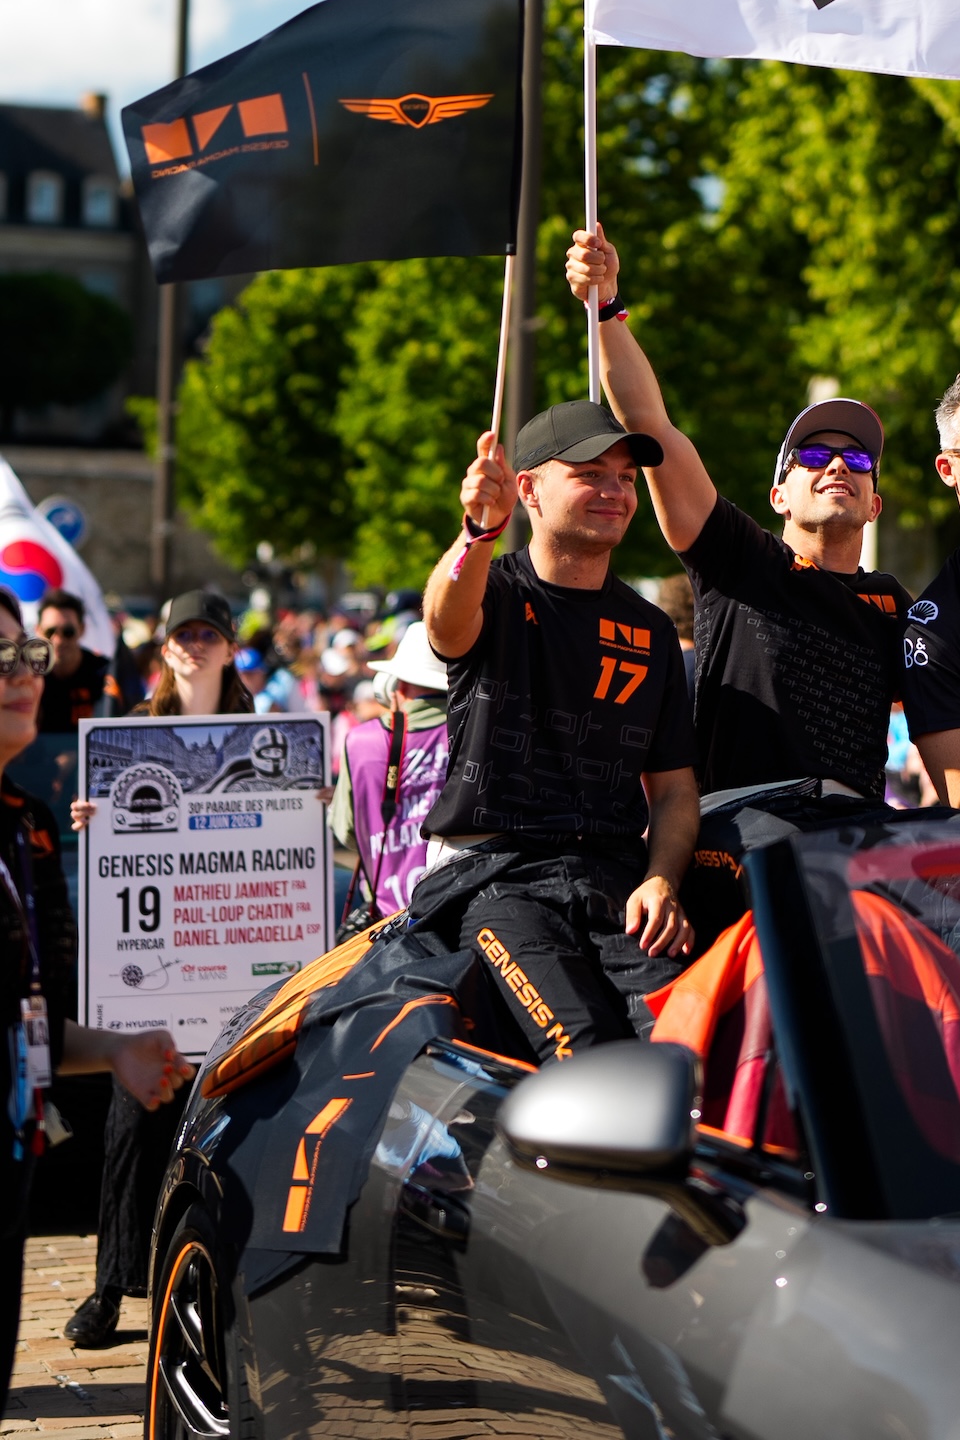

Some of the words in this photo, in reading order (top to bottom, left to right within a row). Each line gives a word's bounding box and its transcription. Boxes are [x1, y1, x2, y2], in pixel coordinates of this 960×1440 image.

[593, 656, 648, 705] 17
[206, 800, 243, 813] PARADE
[245, 799, 263, 812] DES
[265, 797, 304, 811] PILOTES
[98, 854, 174, 878] GENESIS
[179, 850, 247, 875] MAGMA
[252, 847, 316, 872] RACING
[173, 883, 231, 902] MATHIEU
[234, 880, 289, 900] JAMINET
[116, 885, 161, 934] 19
[173, 905, 244, 924] PAUL-LOUP
[248, 902, 294, 921] CHATIN
[116, 937, 165, 951] HYPERCAR
[173, 928, 220, 947] DANIEL
[224, 924, 305, 945] JUNCADELLA
[477, 927, 555, 1028] GENESIS
